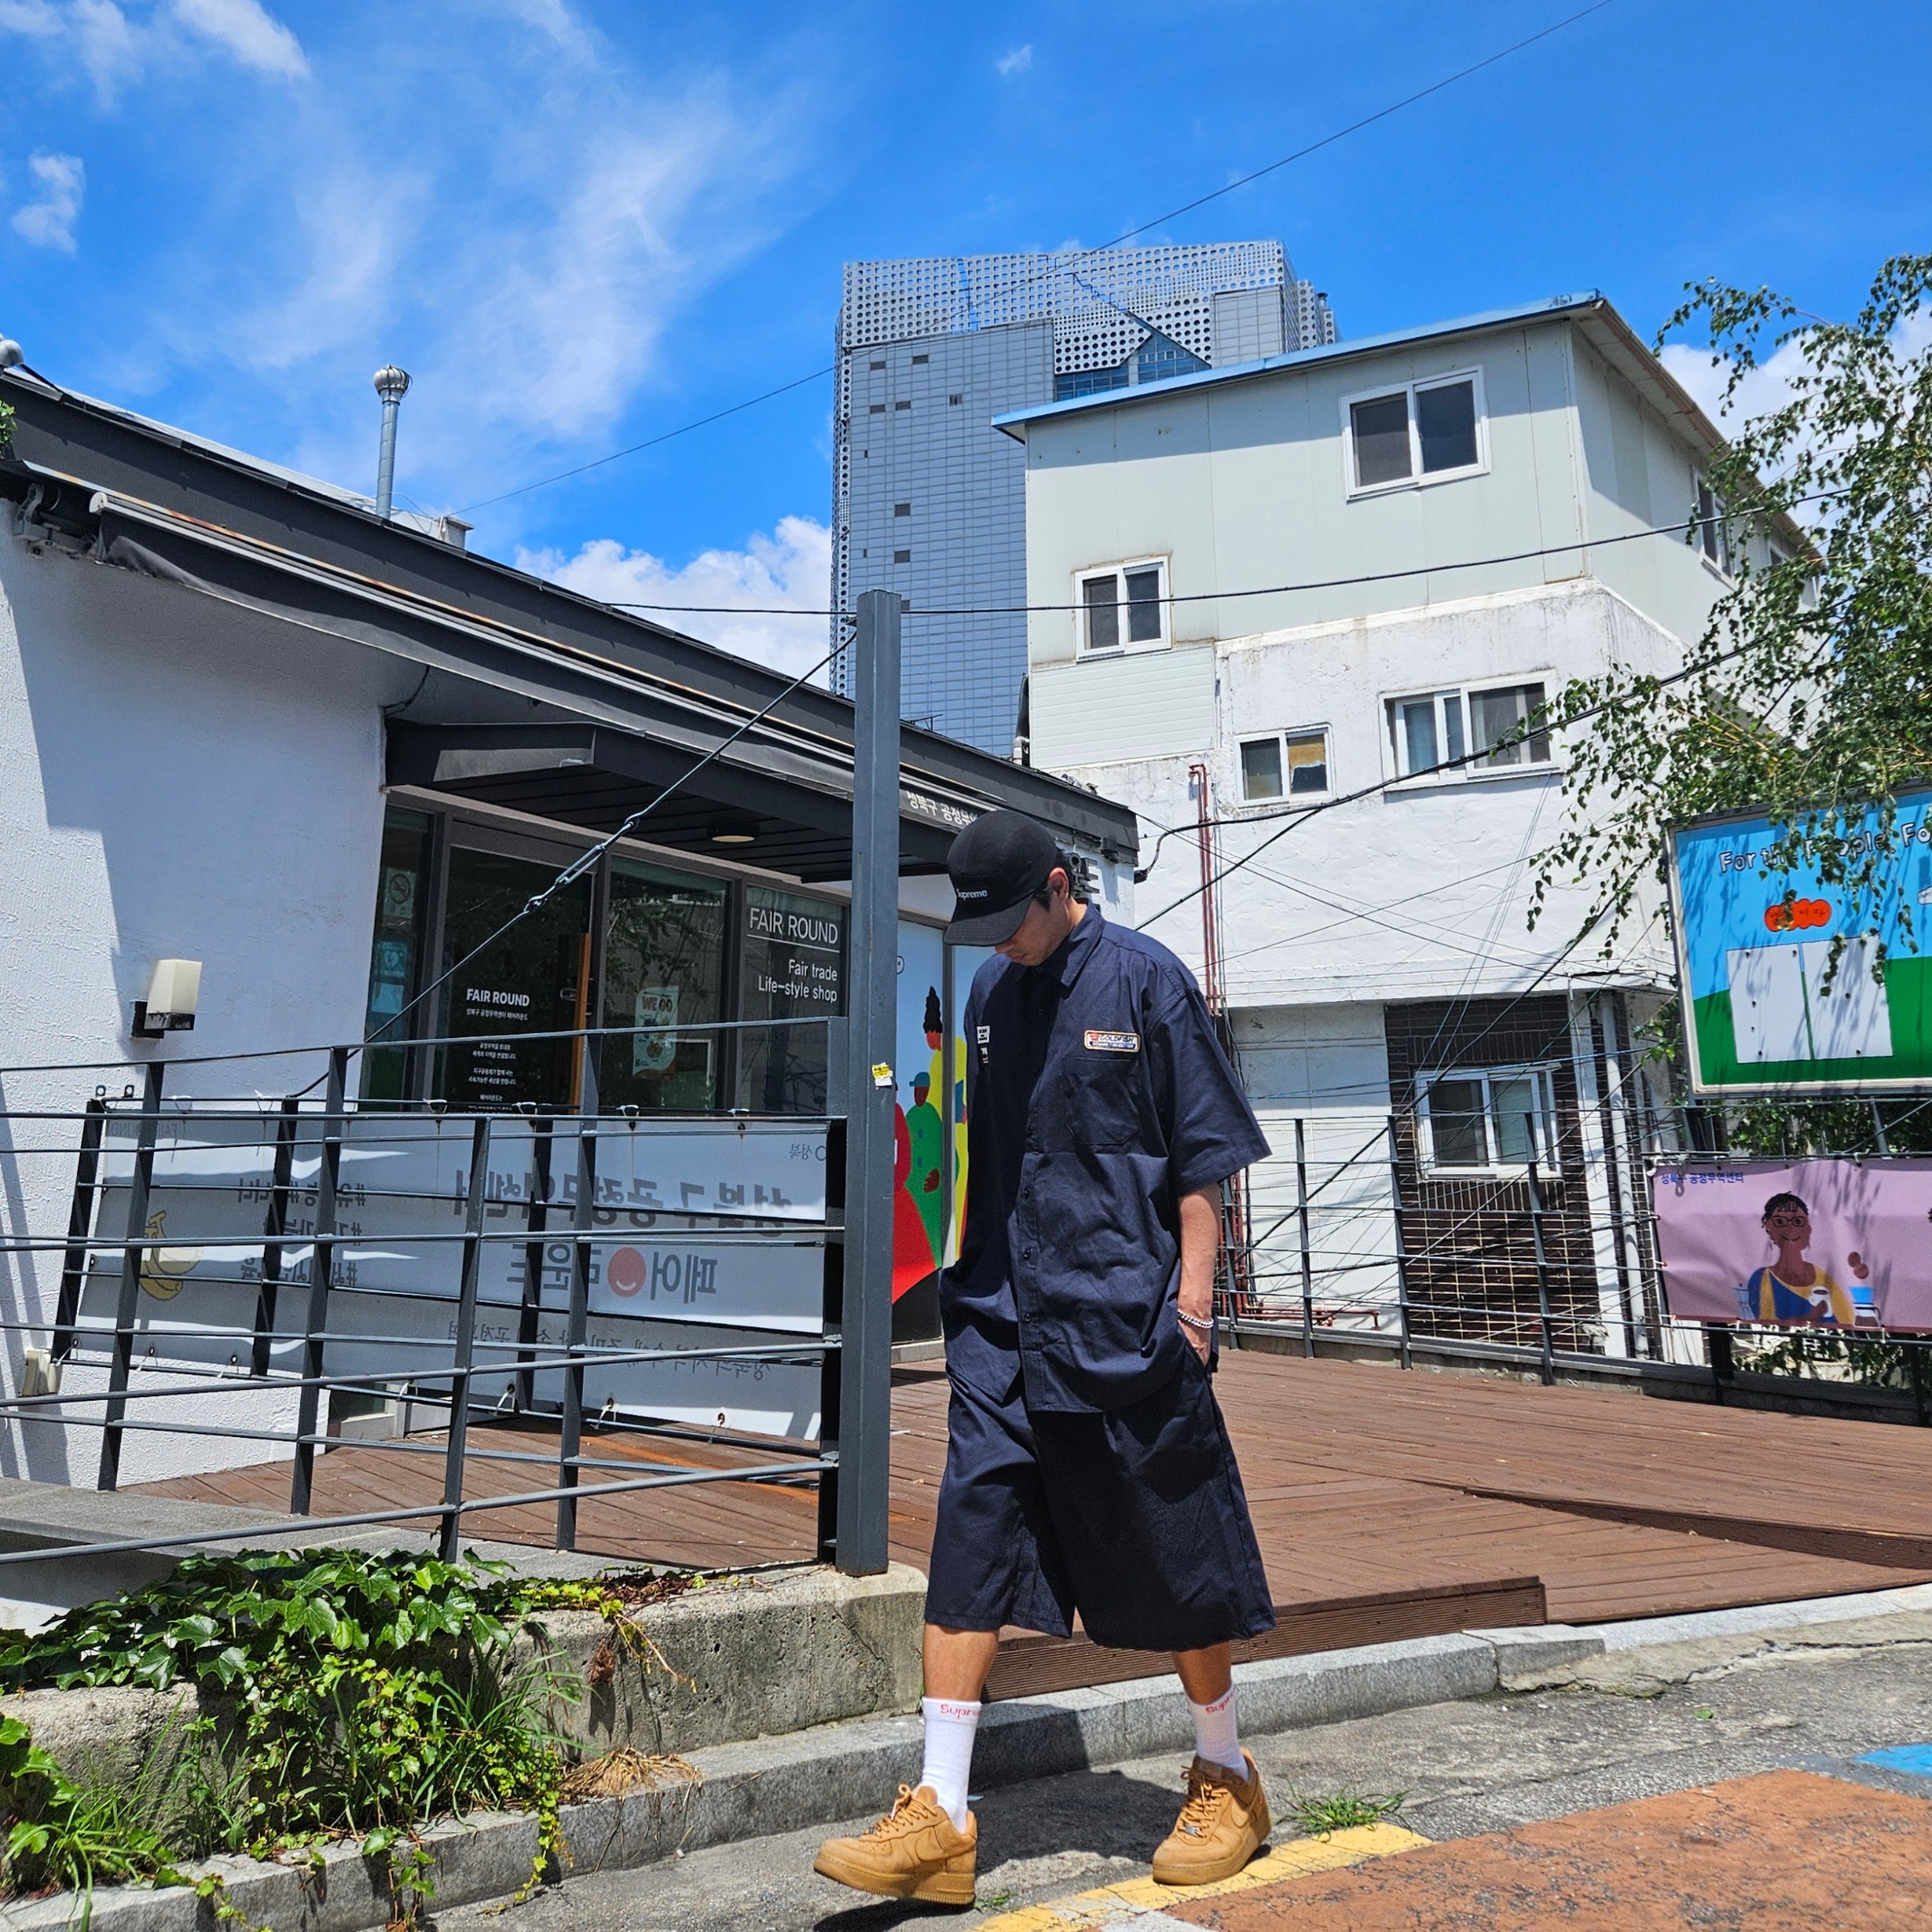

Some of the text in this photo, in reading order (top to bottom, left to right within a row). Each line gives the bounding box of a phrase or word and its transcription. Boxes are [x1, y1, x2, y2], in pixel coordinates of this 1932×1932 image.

[907, 791, 938, 816] 성북구
[1719, 851, 1756, 873] For
[750, 908, 839, 944] FAIR ROUND
[788, 958, 838, 982] Fair trade
[466, 988, 530, 1007] FAIR ROUND
[758, 975, 838, 1004] Life-style shop
